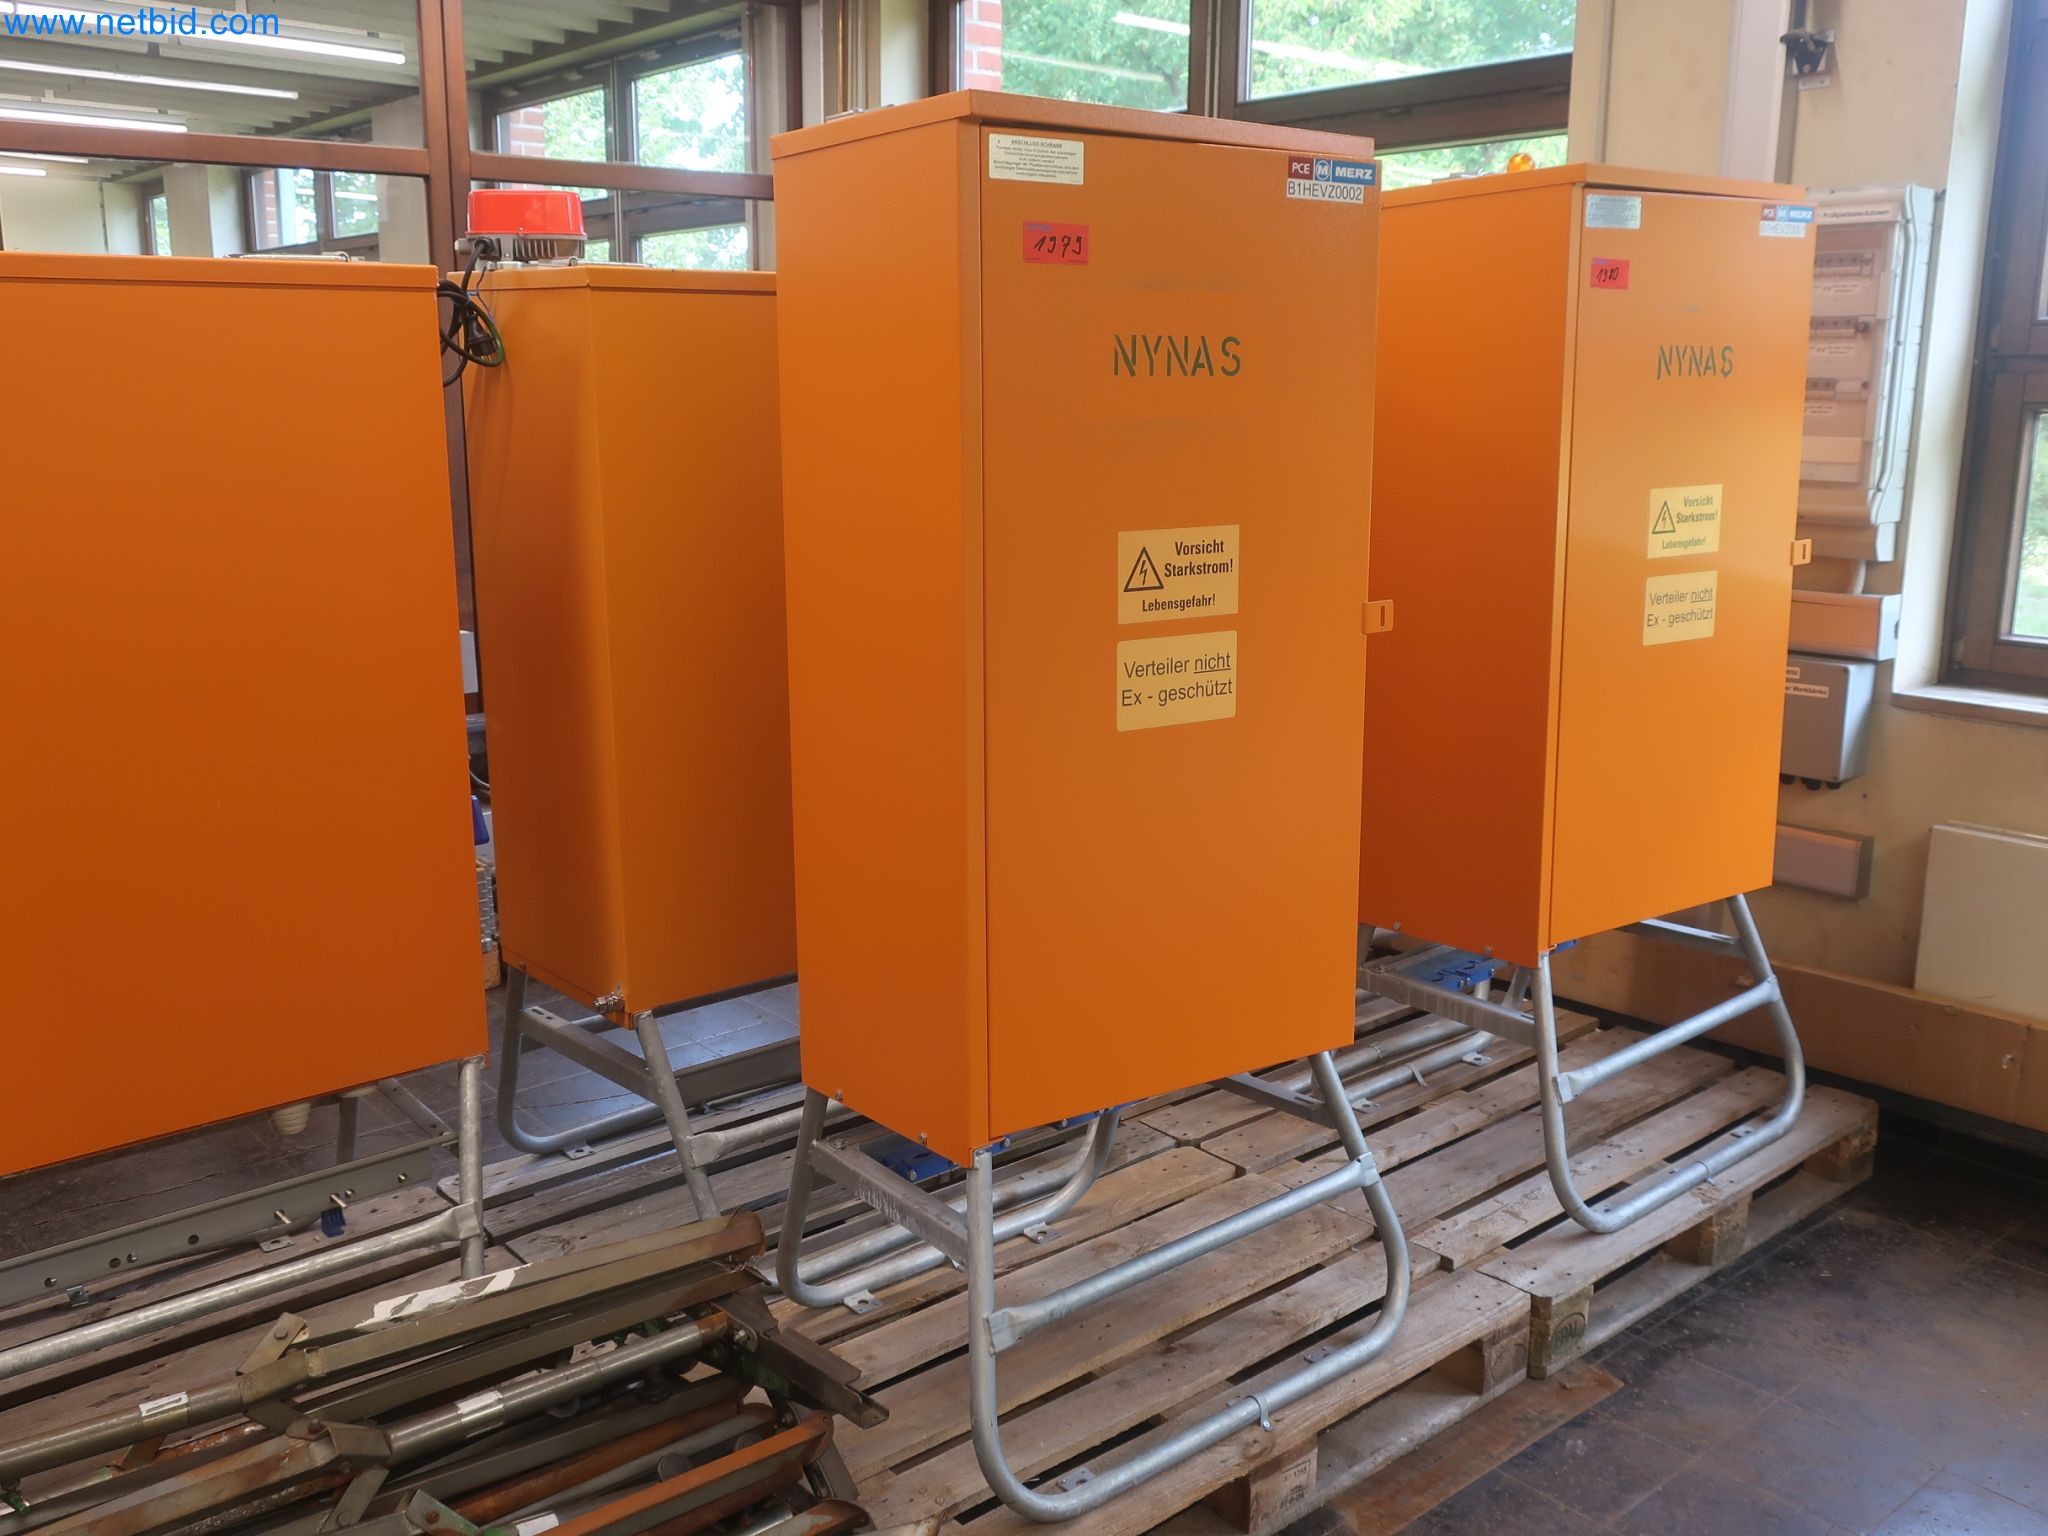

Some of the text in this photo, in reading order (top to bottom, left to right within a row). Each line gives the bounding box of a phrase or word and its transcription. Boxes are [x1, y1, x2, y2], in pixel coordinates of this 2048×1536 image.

[1292, 162, 1310, 174] PCE
[1335, 166, 1373, 180] MERZ
[1288, 181, 1362, 201] B1HEVZ0002
[1034, 235, 1082, 258] 1979
[1596, 266, 1619, 283] 1980
[1114, 334, 1241, 377] NYNAS
[1657, 345, 1734, 379] NYNAS
[1684, 496, 1713, 507] Vorsicht
[1676, 511, 1718, 524] Starkstrom!
[1175, 539, 1225, 556] Vorsicht
[1164, 558, 1233, 577] Starkstrom!
[1142, 593, 1216, 612] Lebensgefahr!
[1650, 588, 1713, 605] Verteiler nicht
[1647, 613, 1660, 627] Ex
[1668, 608, 1713, 628] geschützt
[1124, 652, 1231, 678] Verteiler nicht
[1122, 689, 1143, 707] Ex
[1158, 679, 1233, 707] geschützt
